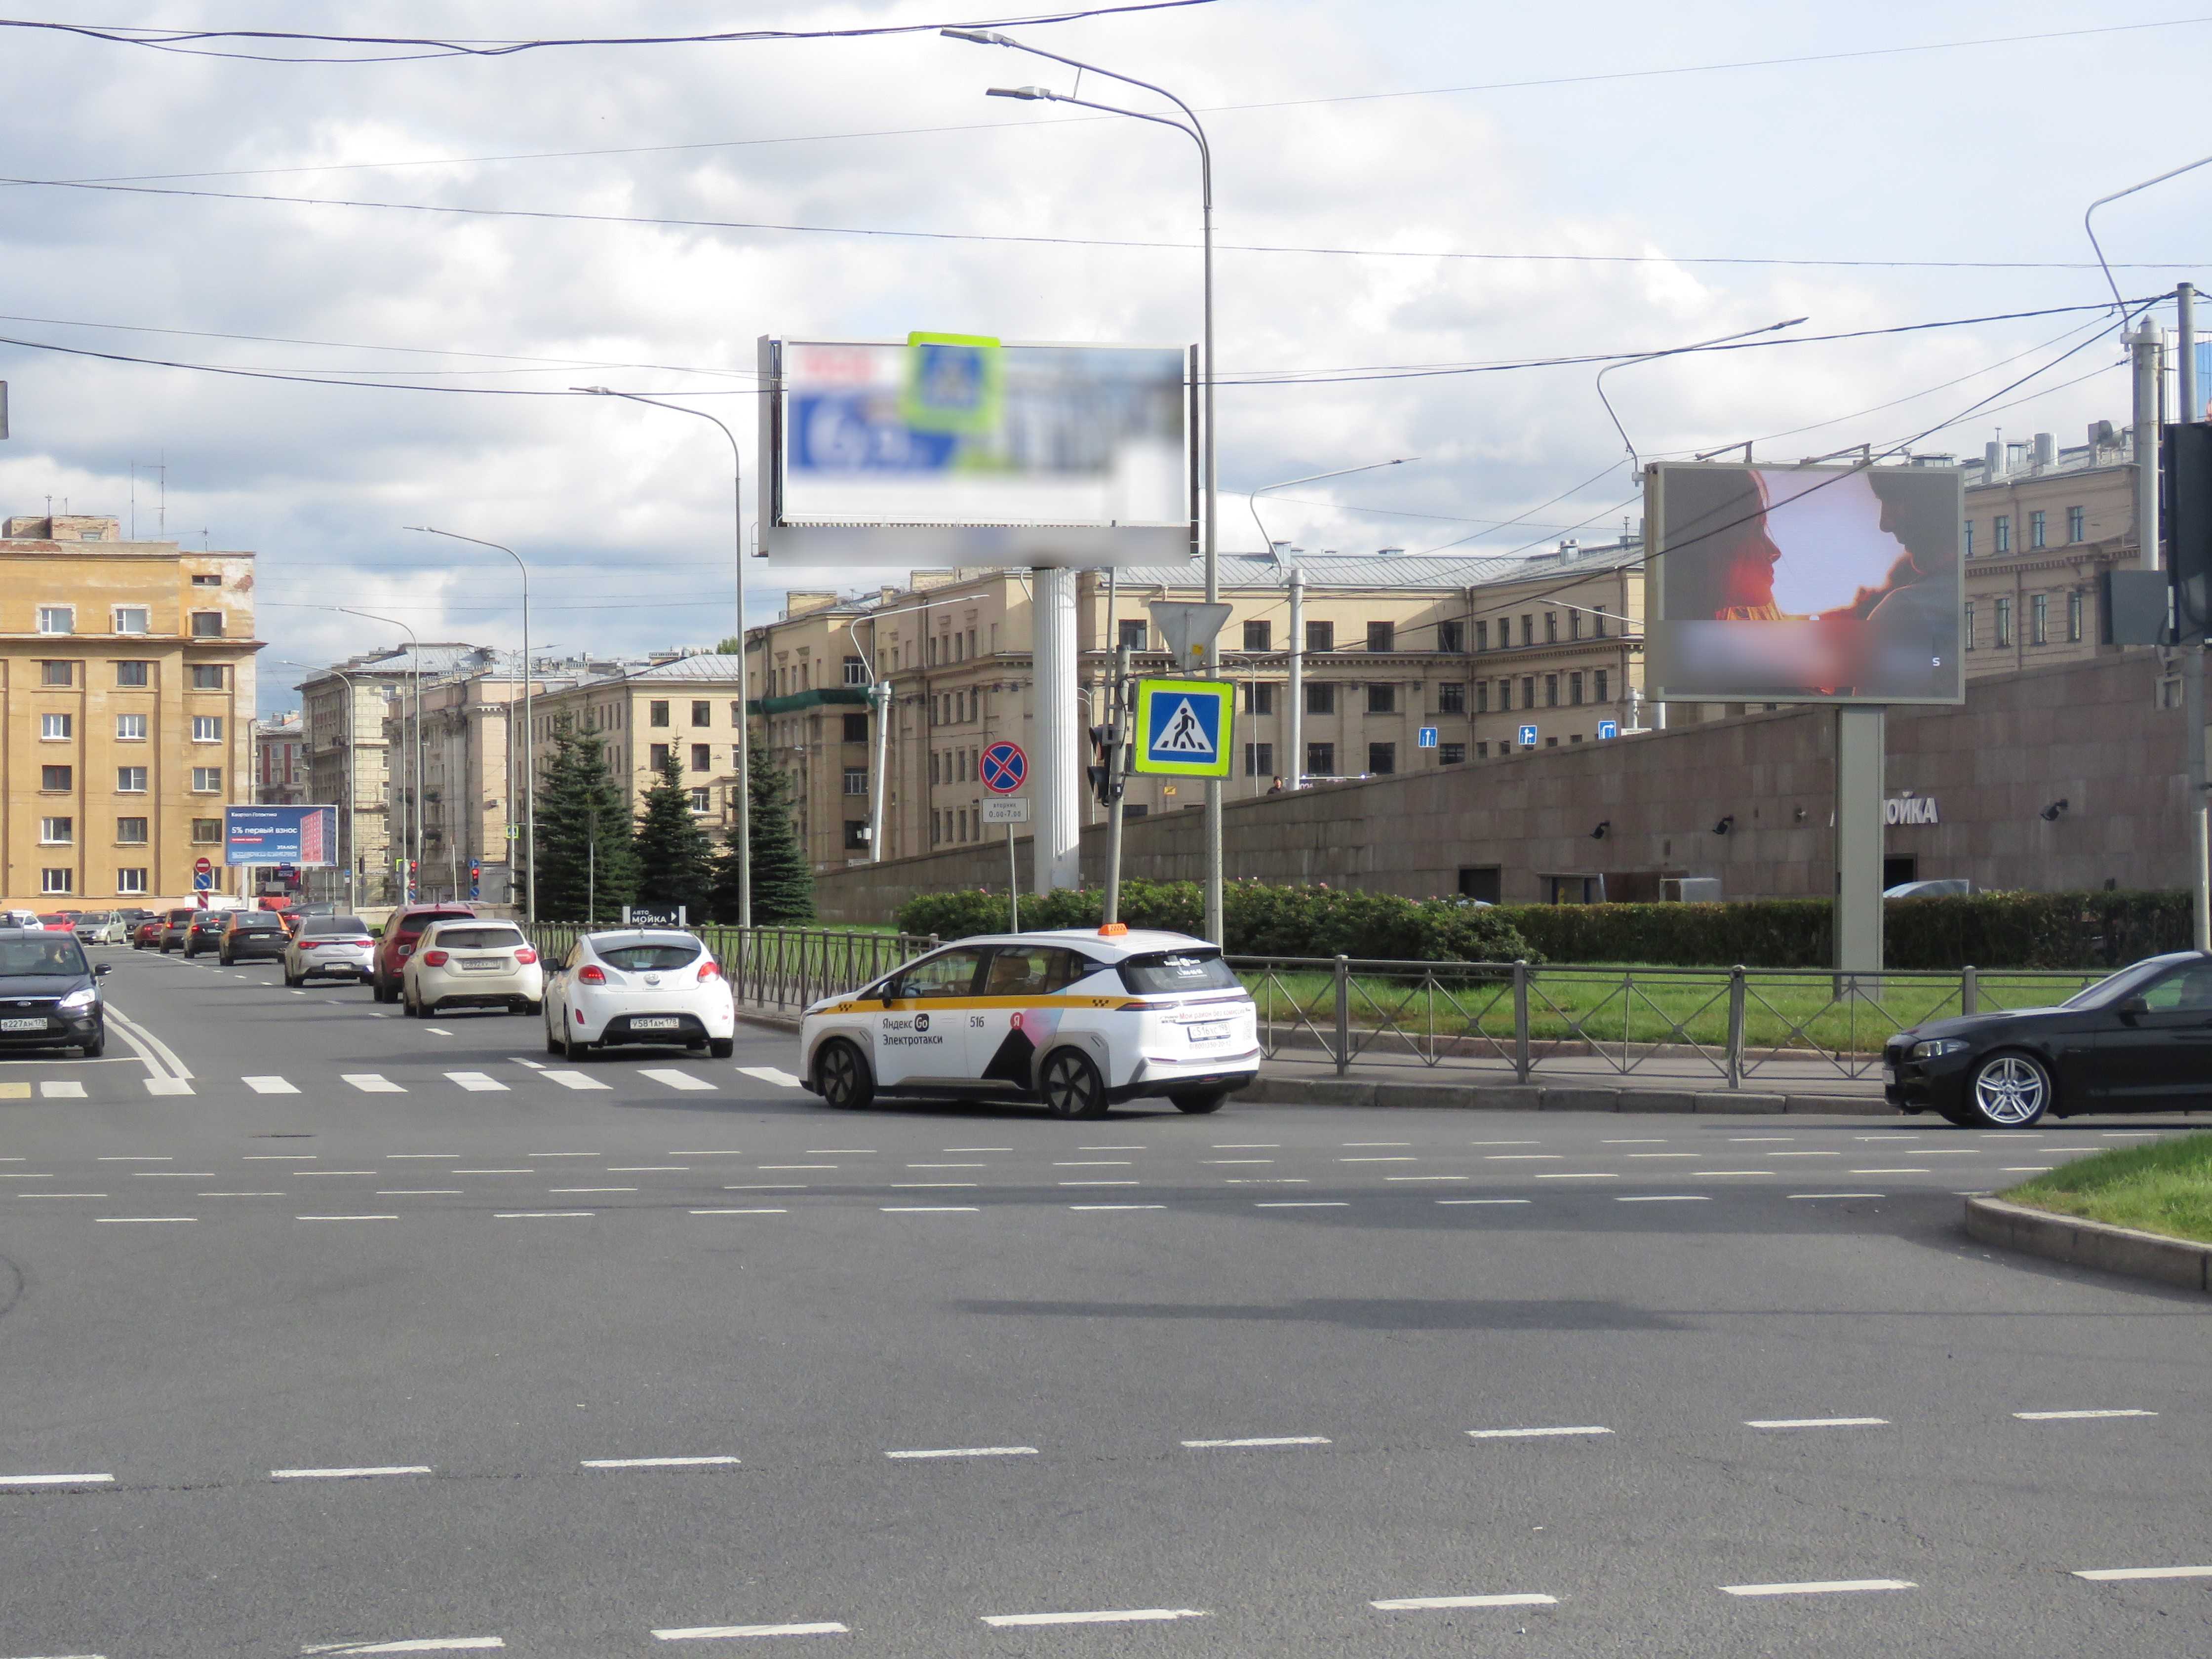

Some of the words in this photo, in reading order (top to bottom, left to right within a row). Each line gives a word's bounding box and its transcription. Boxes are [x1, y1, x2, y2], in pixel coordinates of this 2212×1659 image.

[1884, 790, 1938, 825] ОЙКА
[632, 914, 667, 923] МОЙКА
[883, 1018, 913, 1030] Яндекс
[916, 1016, 928, 1028] Go
[970, 1016, 985, 1028] 516
[1013, 1014, 1021, 1027] Я
[883, 1034, 944, 1047] Электротакси
